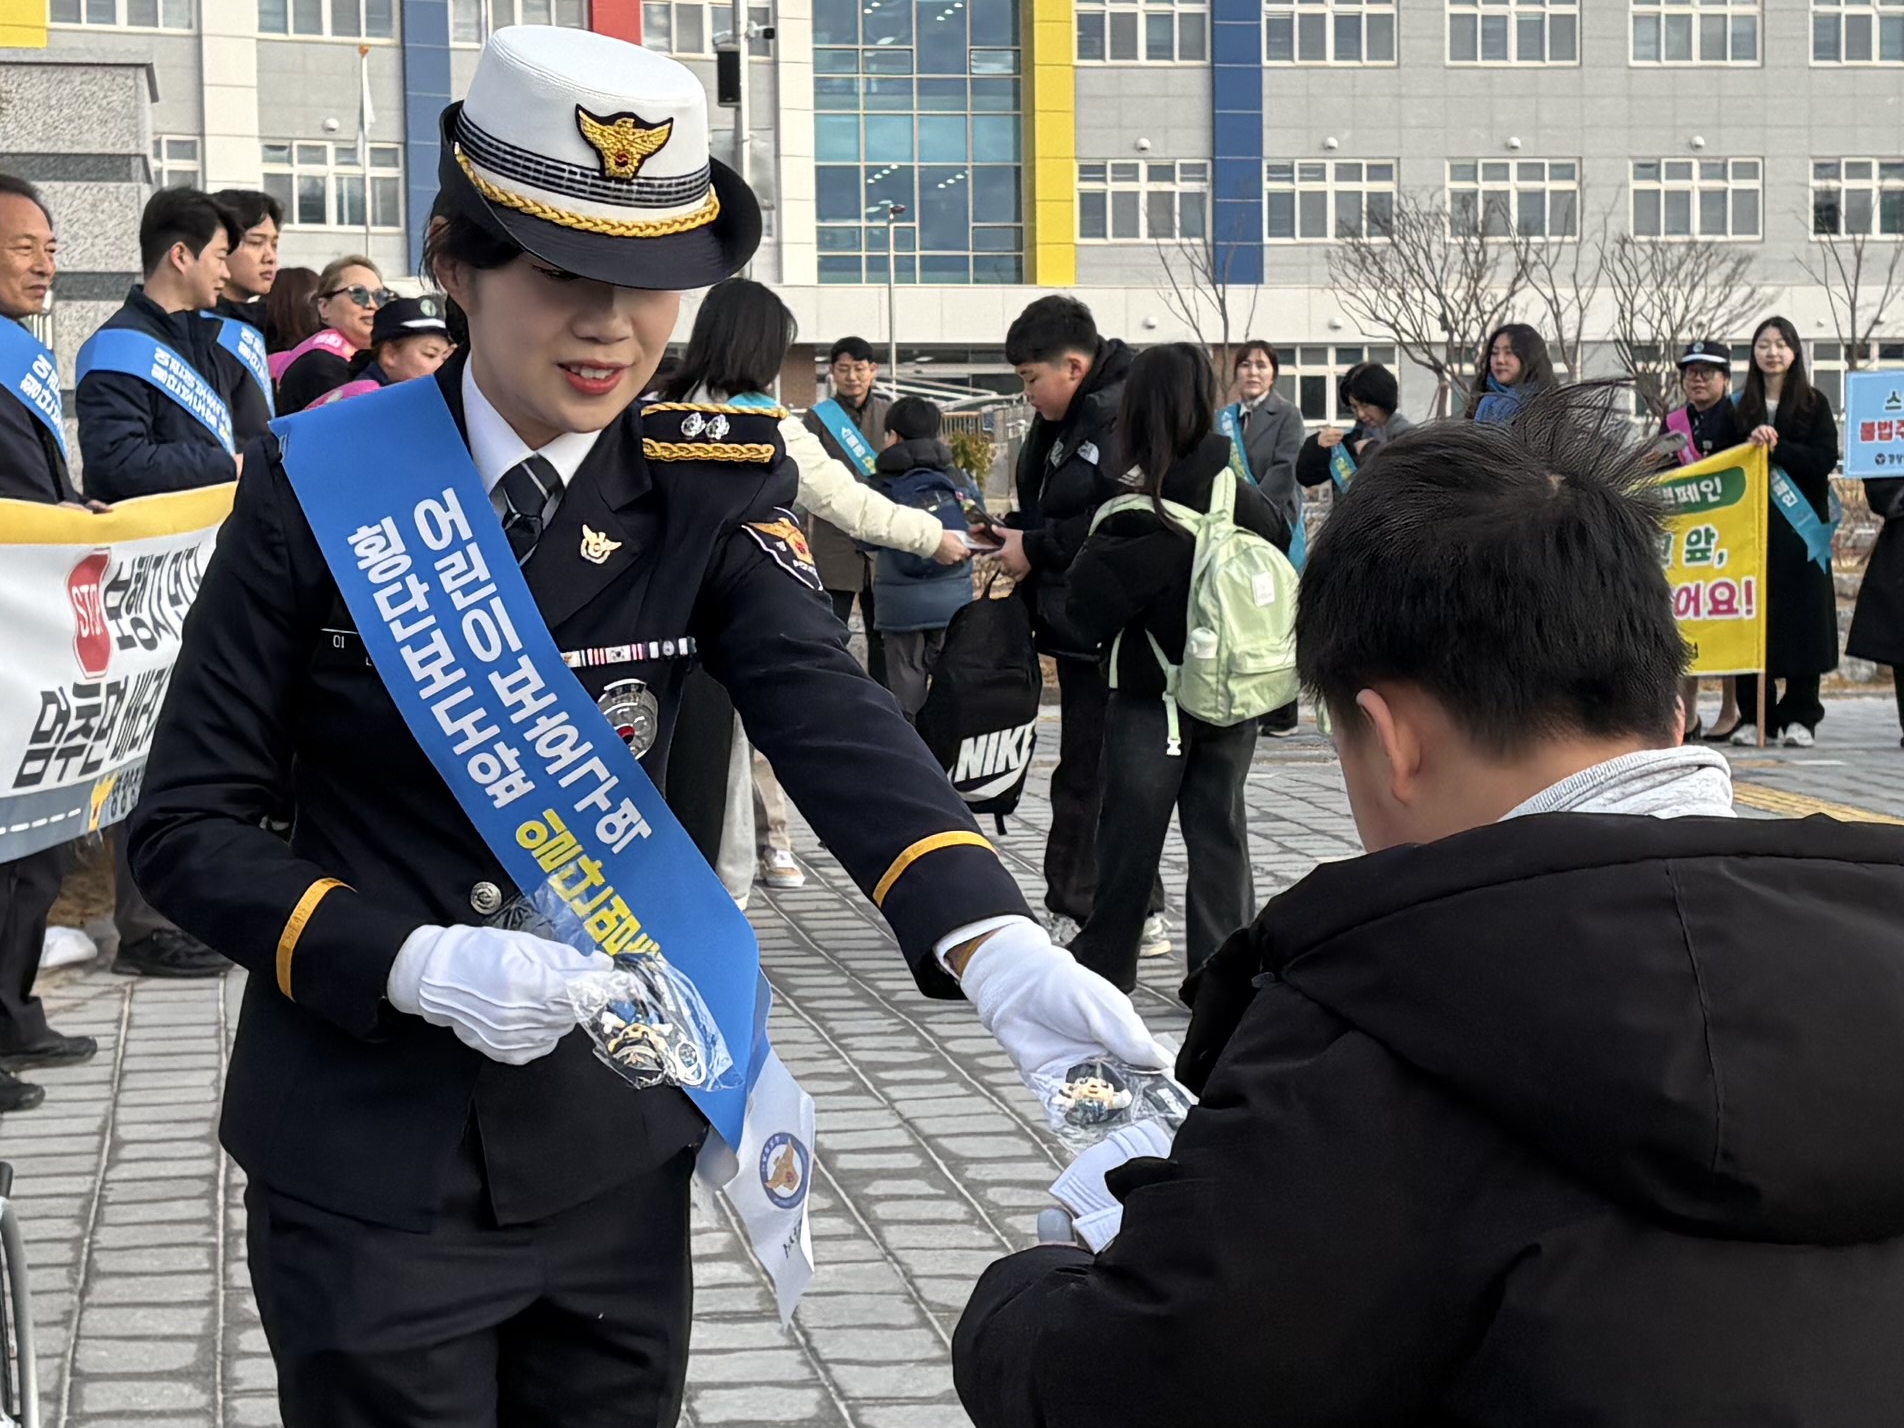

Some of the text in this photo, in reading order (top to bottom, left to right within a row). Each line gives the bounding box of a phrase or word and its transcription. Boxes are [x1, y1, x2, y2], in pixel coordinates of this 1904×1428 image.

[1685, 526, 1726, 566] 앞,
[1673, 579, 1755, 617] 어요!
[347, 516, 536, 808] 횡단보도앞
[413, 487, 652, 855] 어린이보호구역
[110, 662, 175, 760] 배려
[953, 717, 1037, 783] NIKE
